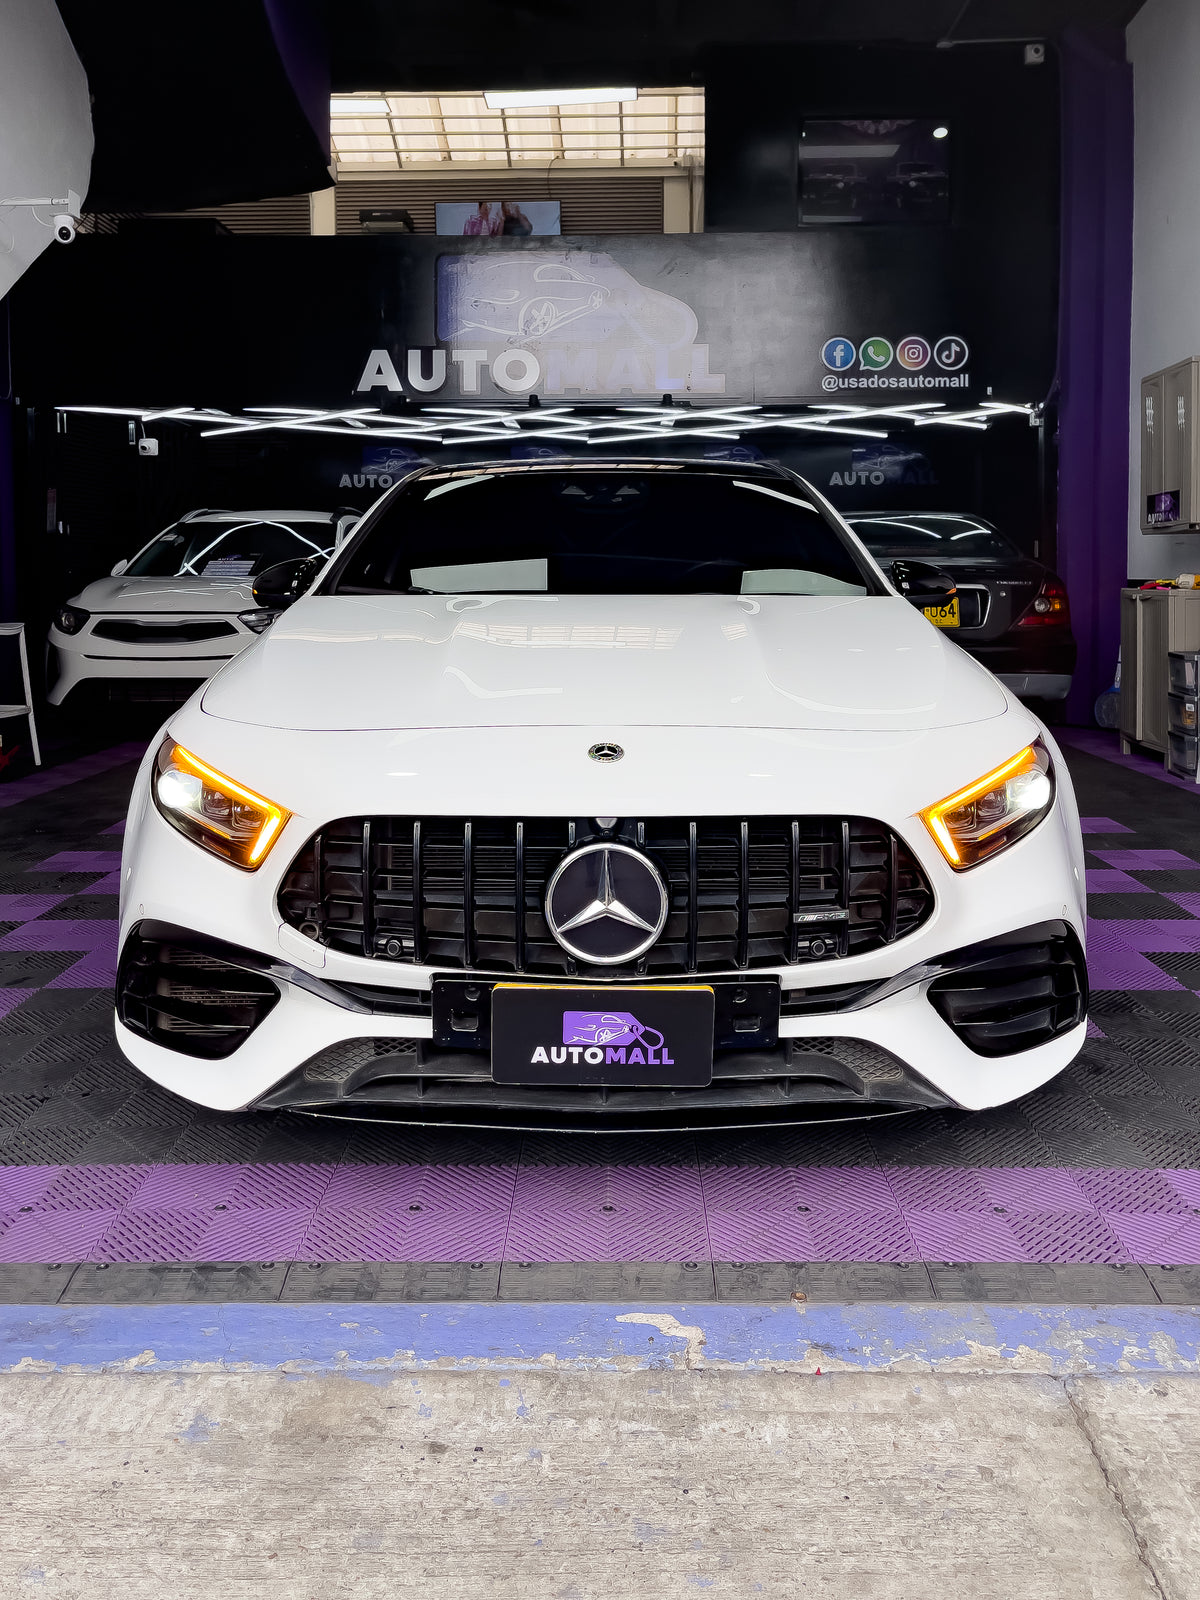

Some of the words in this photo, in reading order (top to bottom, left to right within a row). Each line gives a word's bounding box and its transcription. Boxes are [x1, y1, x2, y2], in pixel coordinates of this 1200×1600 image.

[356, 349, 726, 394] AUTOMALL
[821, 374, 969, 392] @usadosautomall
[531, 1046, 675, 1065] AUTOMALL
